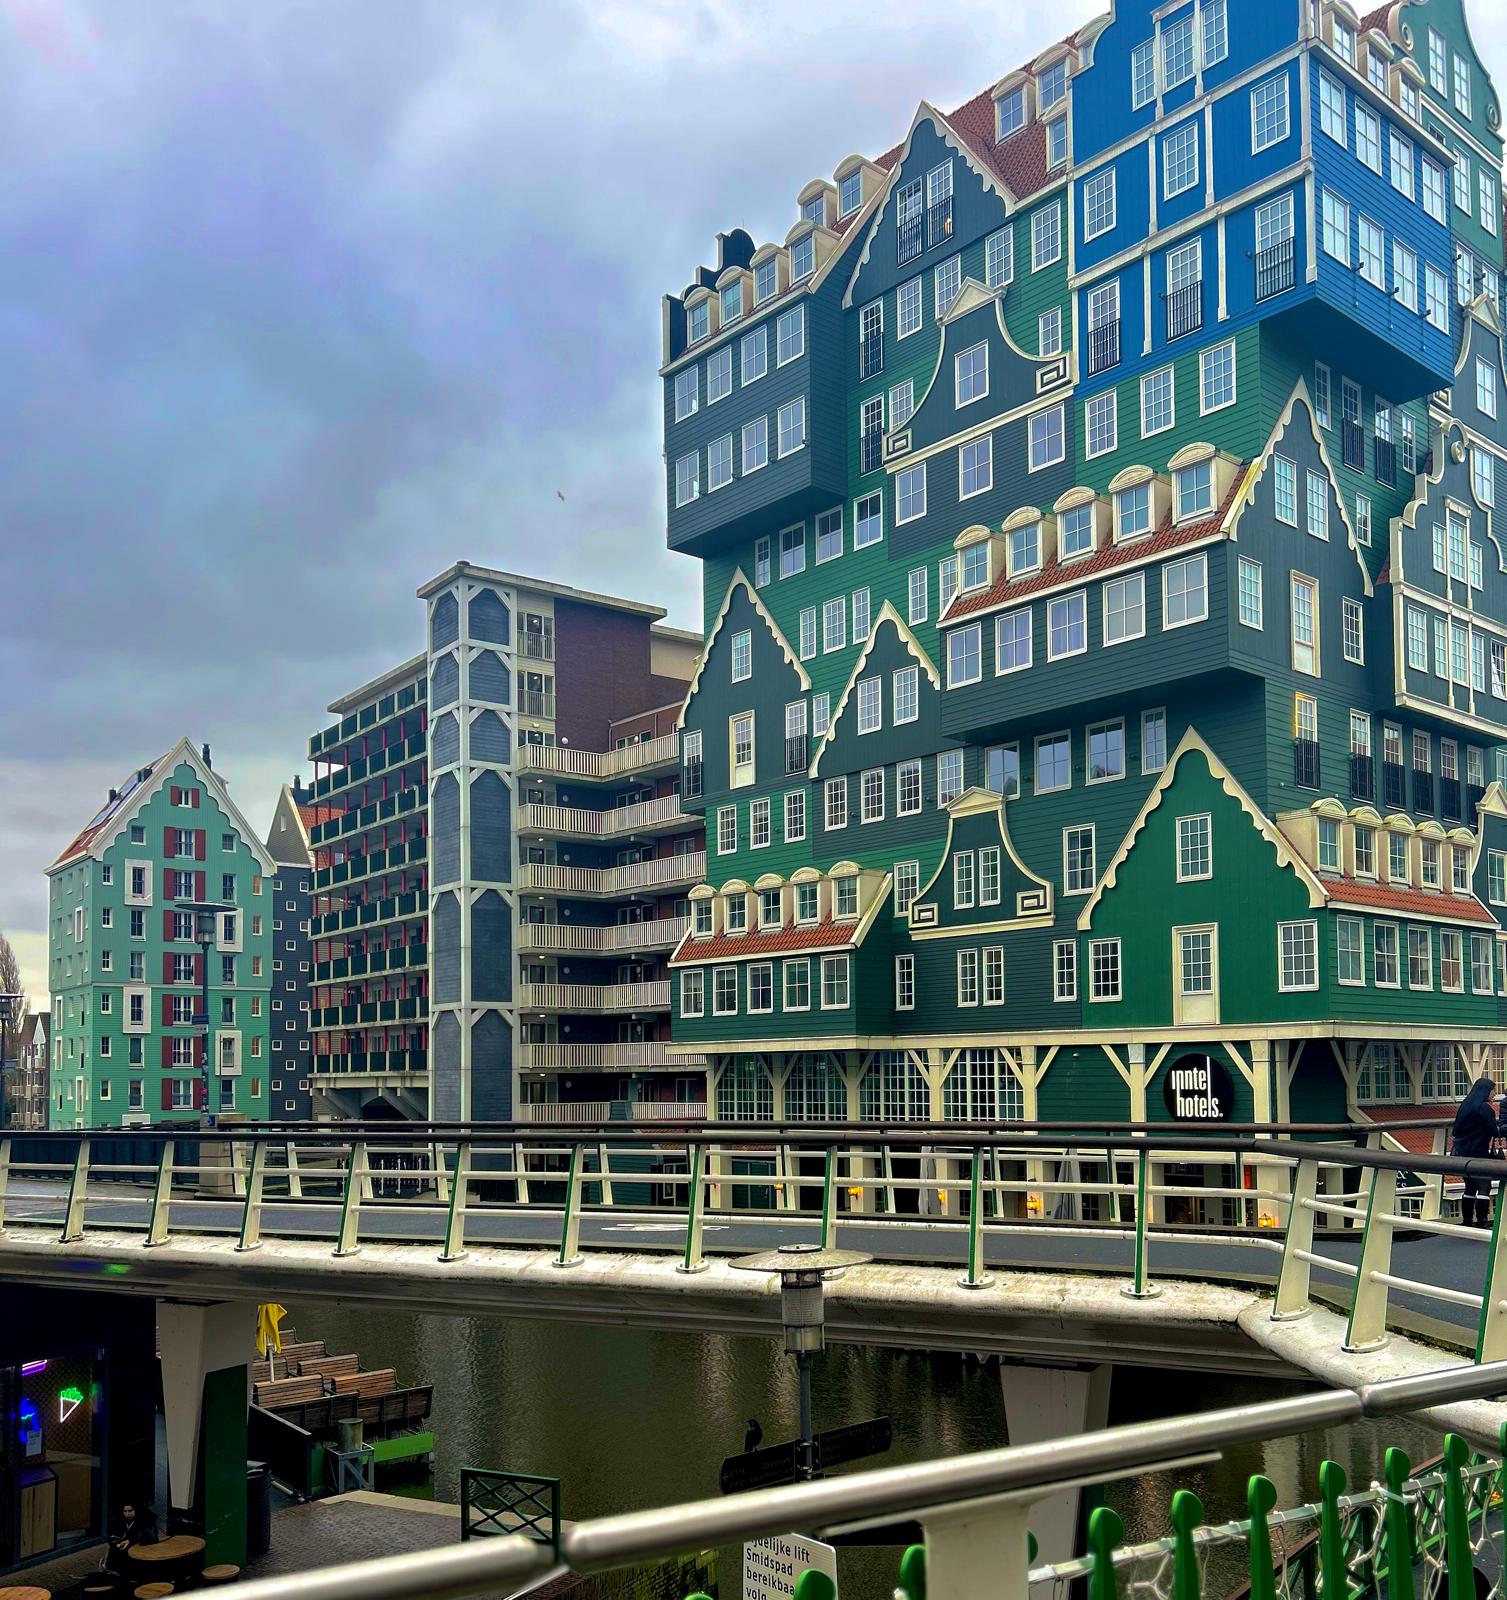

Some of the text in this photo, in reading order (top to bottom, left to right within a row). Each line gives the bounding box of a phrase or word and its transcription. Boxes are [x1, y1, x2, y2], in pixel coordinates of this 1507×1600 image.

[1171, 1055, 1211, 1091] inntel
[746, 1547, 793, 1577] Smidspad
[794, 1545, 810, 1563] lift
[746, 1565, 795, 1596] bereikbaa
